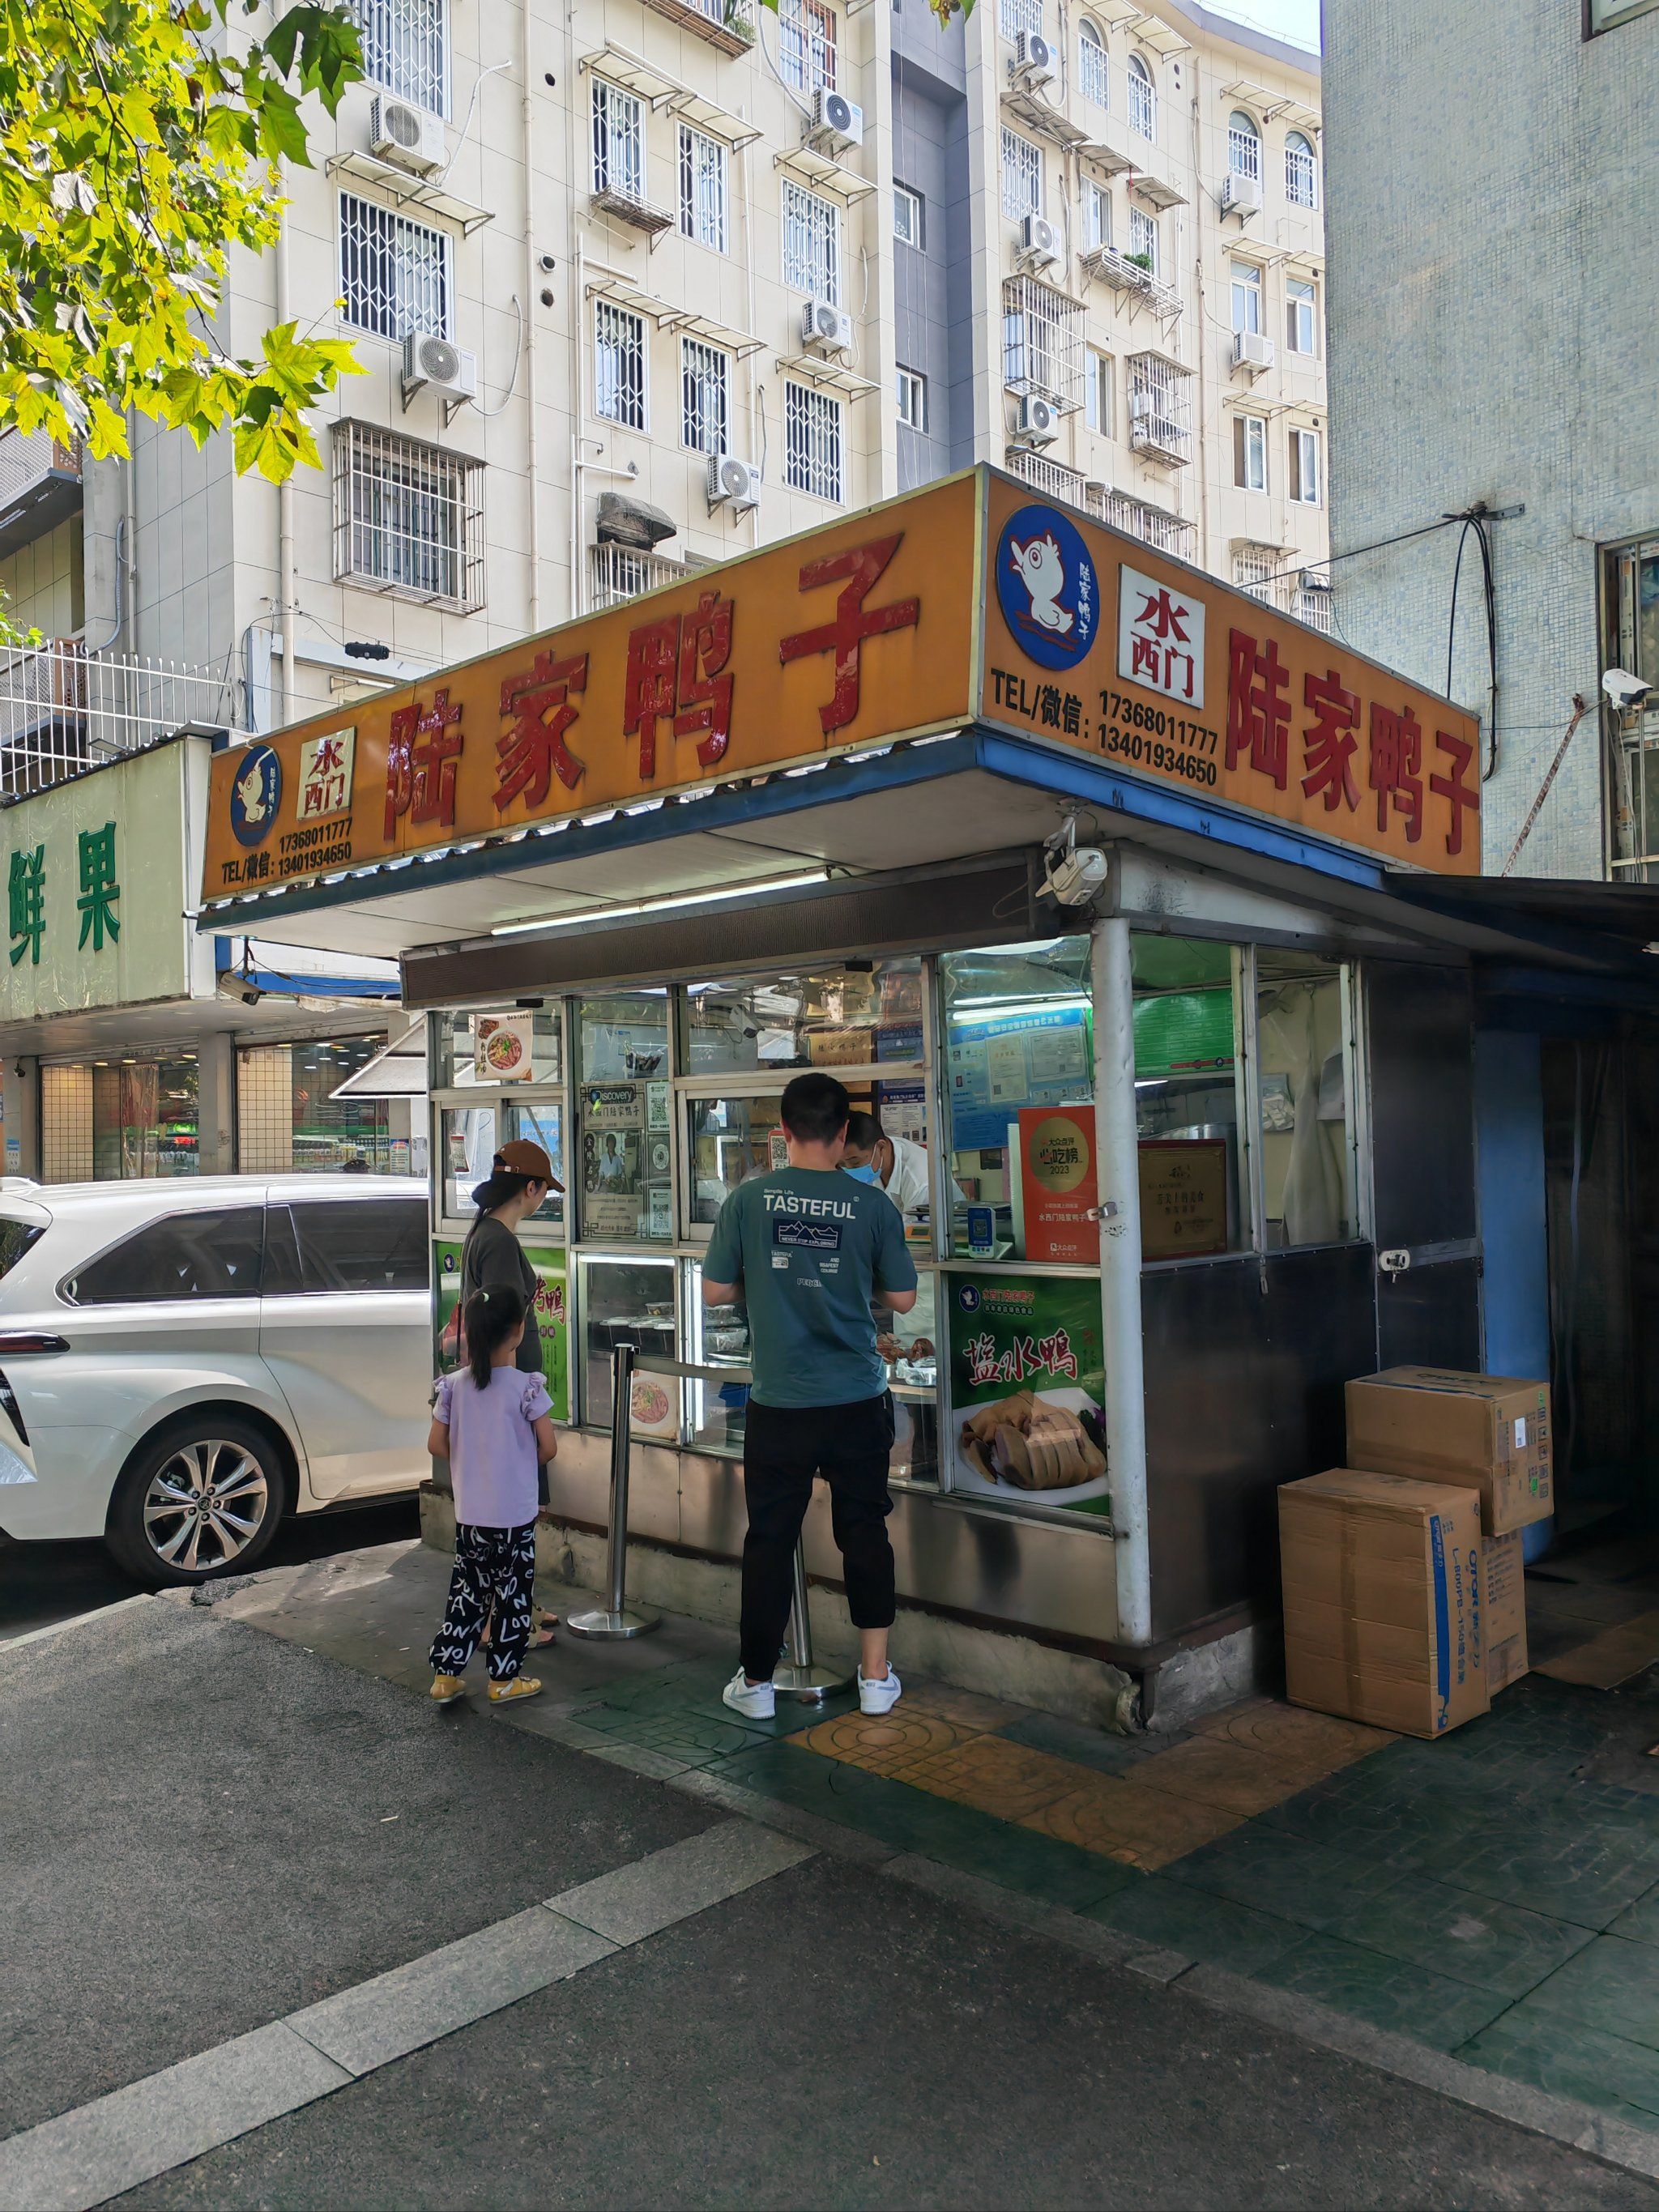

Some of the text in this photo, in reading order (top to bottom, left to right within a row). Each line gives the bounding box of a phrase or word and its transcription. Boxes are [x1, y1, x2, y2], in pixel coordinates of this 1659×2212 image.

[1078, 561, 1091, 640] 陆家鸭子
[1135, 587, 1191, 643] 水
[383, 532, 920, 842] 陆家鸭子
[1131, 632, 1195, 698] 西门
[1099, 690, 1218, 755] 17368011777
[1225, 628, 1480, 855] 陆家鸭子
[309, 738, 345, 778] 水
[1098, 723, 1218, 786] 13401934650
[304, 773, 345, 815] 西门
[278, 842, 352, 877] 13401934650
[279, 817, 353, 854] 17368011777
[8, 820, 121, 967] 鲜果
[1039, 1147, 1079, 1165] 必吃榜
[1050, 1165, 1070, 1174] 2023
[763, 1194, 856, 1220] TASTEFUL
